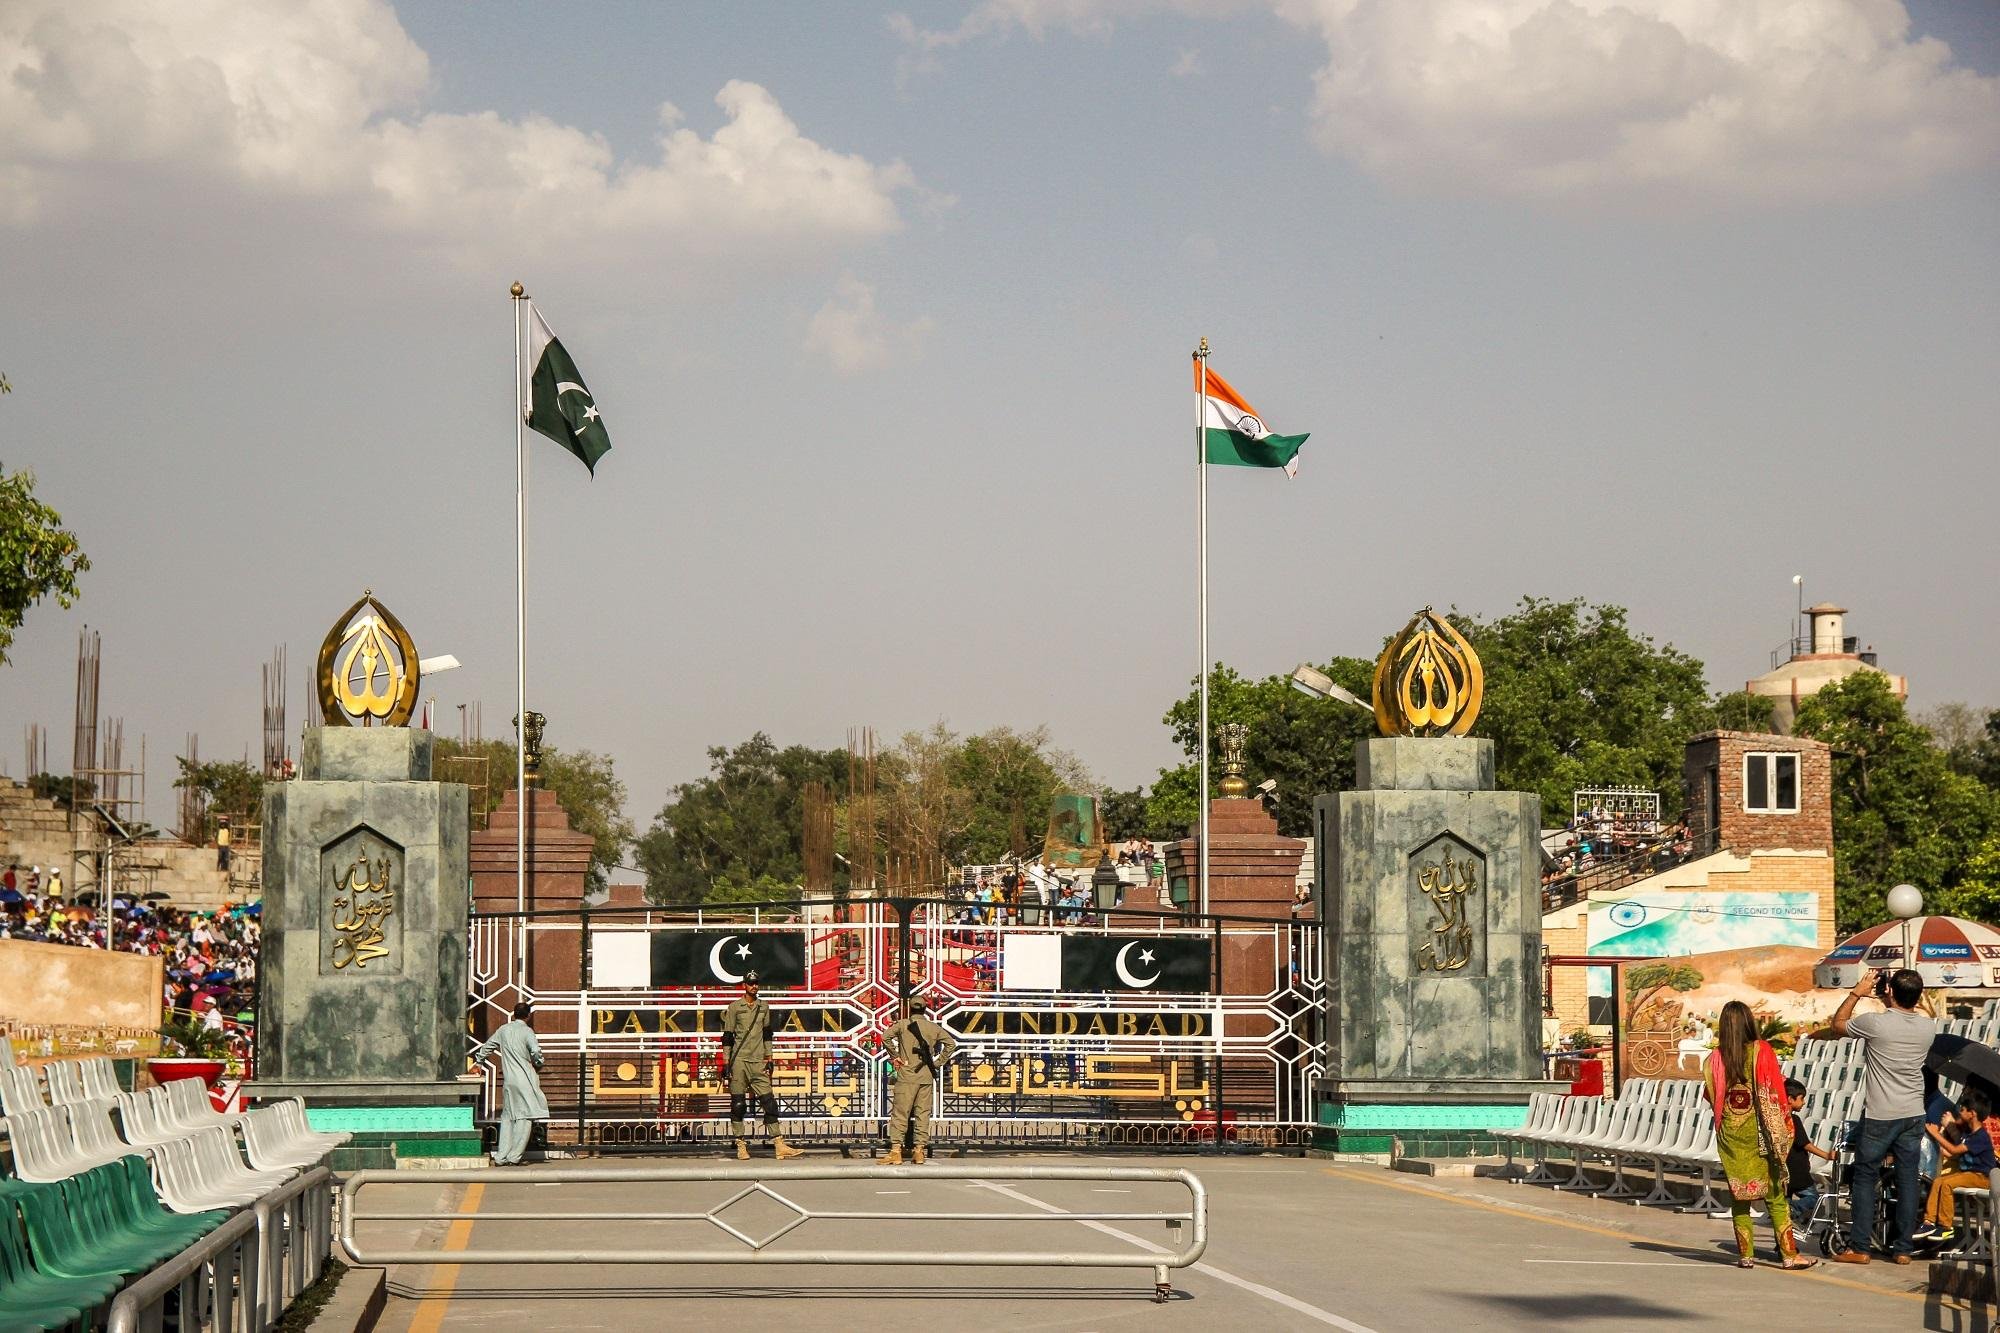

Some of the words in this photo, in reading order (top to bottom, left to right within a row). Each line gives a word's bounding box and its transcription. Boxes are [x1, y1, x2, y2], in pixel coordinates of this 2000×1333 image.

[1732, 907, 1769, 916] SECOND
[1771, 907, 1782, 915] TO
[1784, 907, 1809, 915] NONE
[596, 1008, 844, 1034] PAKIAN
[963, 1011, 1205, 1036] ZINDABAD
